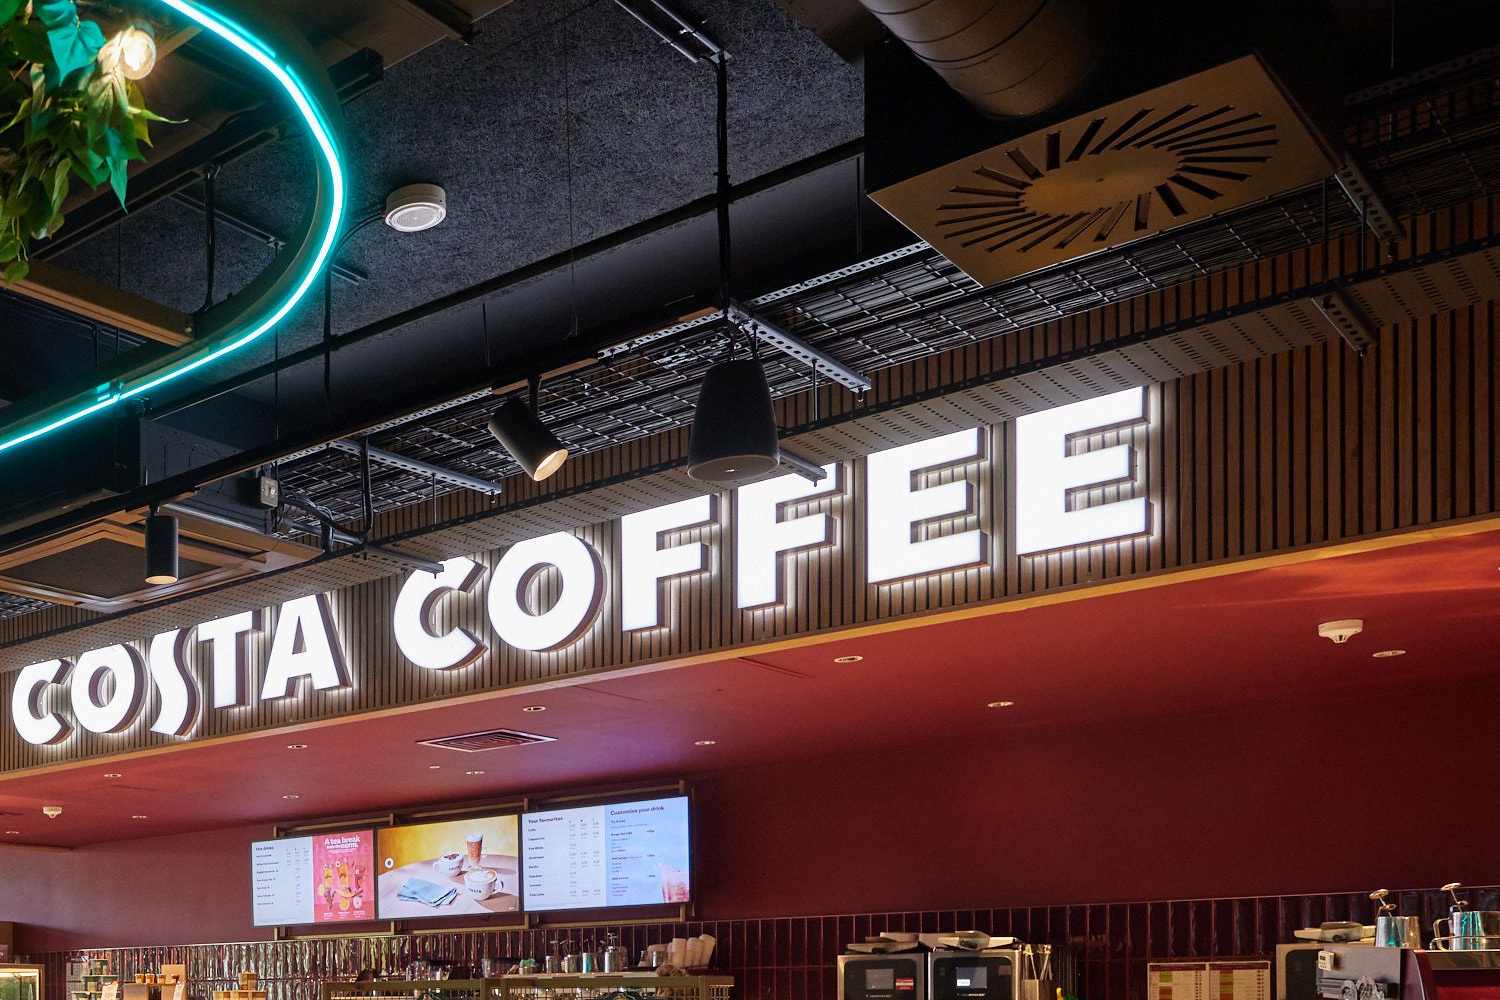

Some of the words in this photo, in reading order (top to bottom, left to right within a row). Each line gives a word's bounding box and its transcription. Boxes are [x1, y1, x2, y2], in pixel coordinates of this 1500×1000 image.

[12, 593, 350, 744] COSTA
[394, 386, 1153, 671] COFFEE
[341, 835, 361, 844] break
